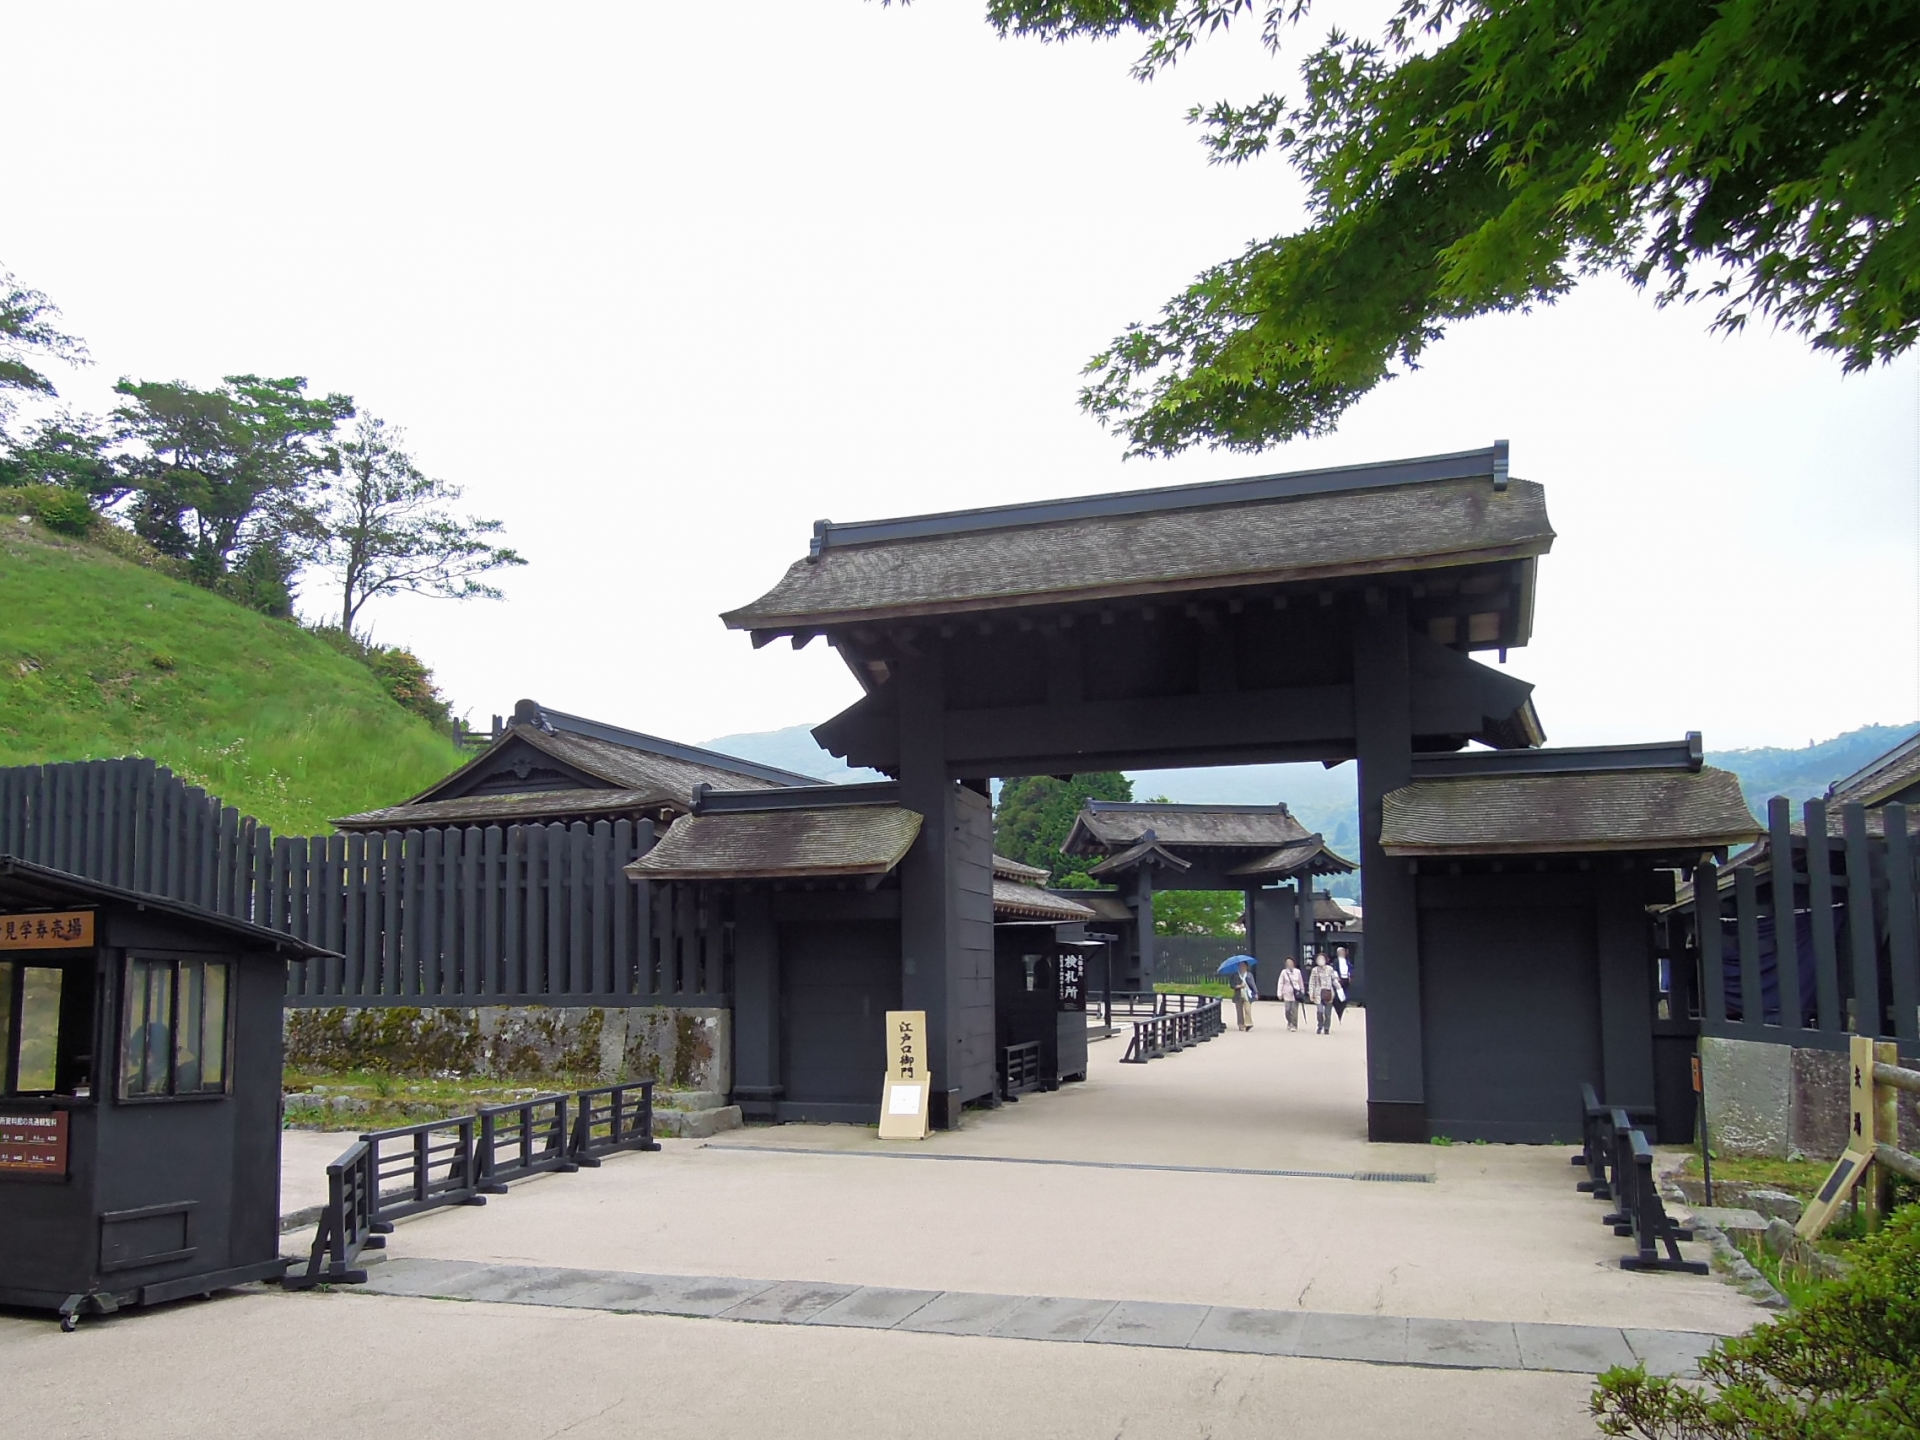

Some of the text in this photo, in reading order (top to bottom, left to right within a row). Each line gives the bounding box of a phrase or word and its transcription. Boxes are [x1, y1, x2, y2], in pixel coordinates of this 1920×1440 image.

[0, 917, 82, 941] 見学券売場
[1064, 954, 1079, 1000] 検札所
[899, 1021, 914, 1079] 江戸口御門
